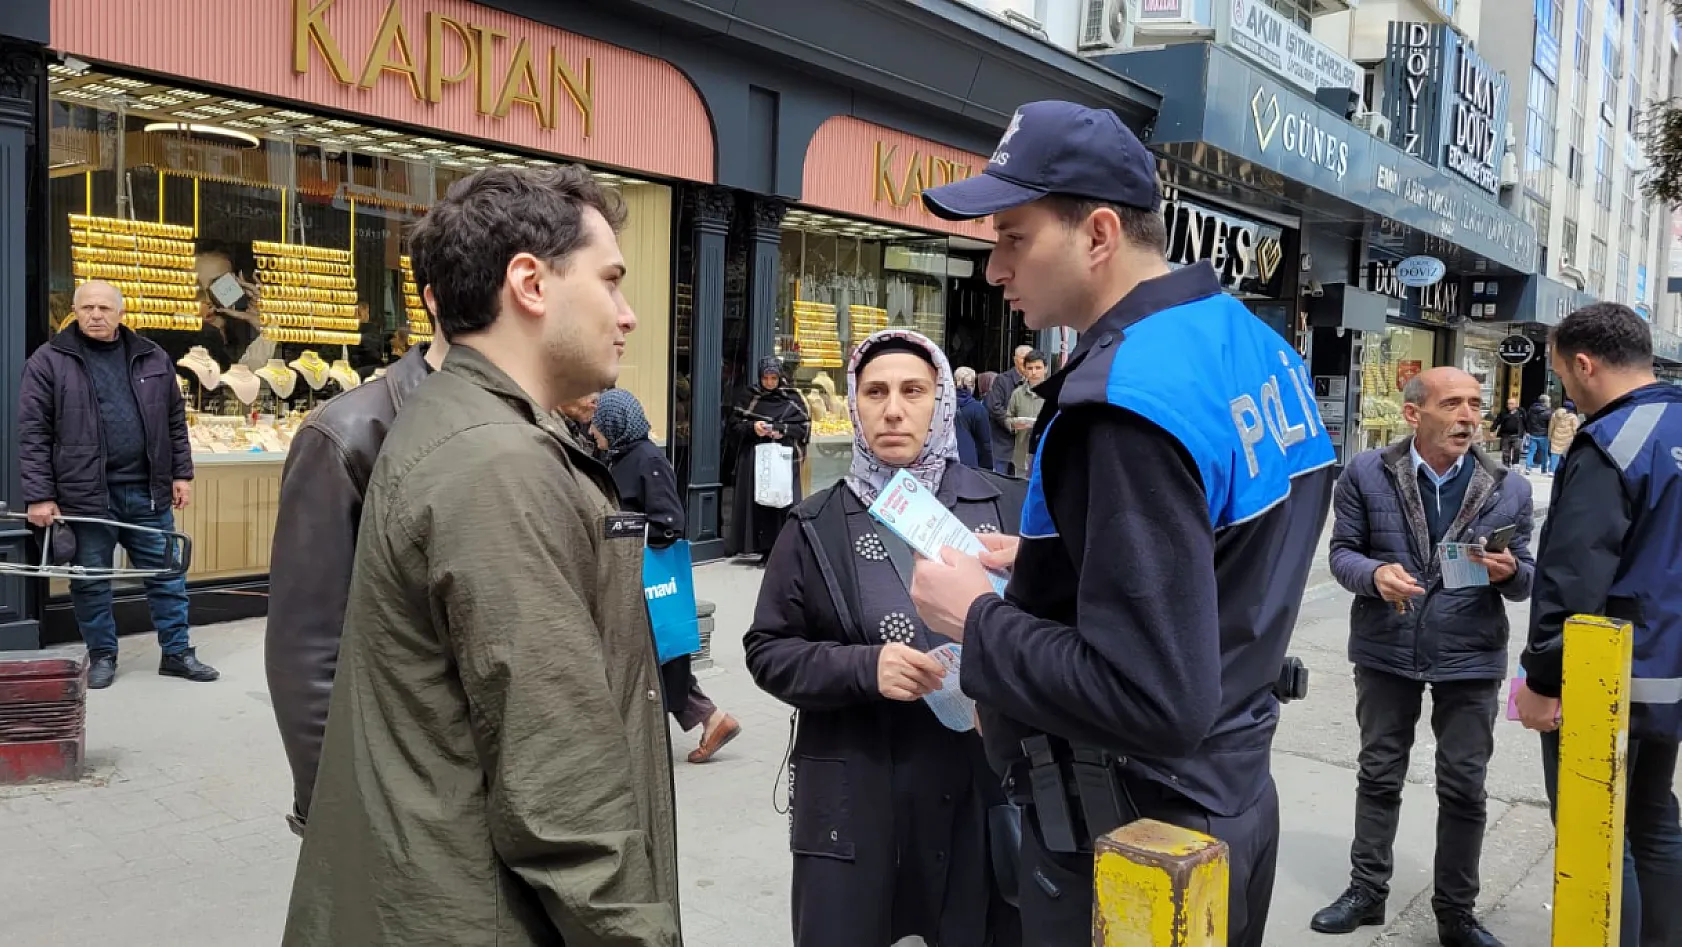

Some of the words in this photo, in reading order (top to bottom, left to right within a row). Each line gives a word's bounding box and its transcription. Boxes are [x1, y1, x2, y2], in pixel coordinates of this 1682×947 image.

[1246, 5, 1282, 47] AKIN
[292, 0, 594, 138] KAPTAN
[1406, 24, 1428, 157] DÖVİZ
[1457, 36, 1502, 112] İLKAY
[1283, 111, 1349, 182] GÜNEŞ
[1457, 104, 1497, 168] DÖVİZ
[1161, 187, 1253, 290] ÜNEŞ
[644, 576, 678, 600] mavi
